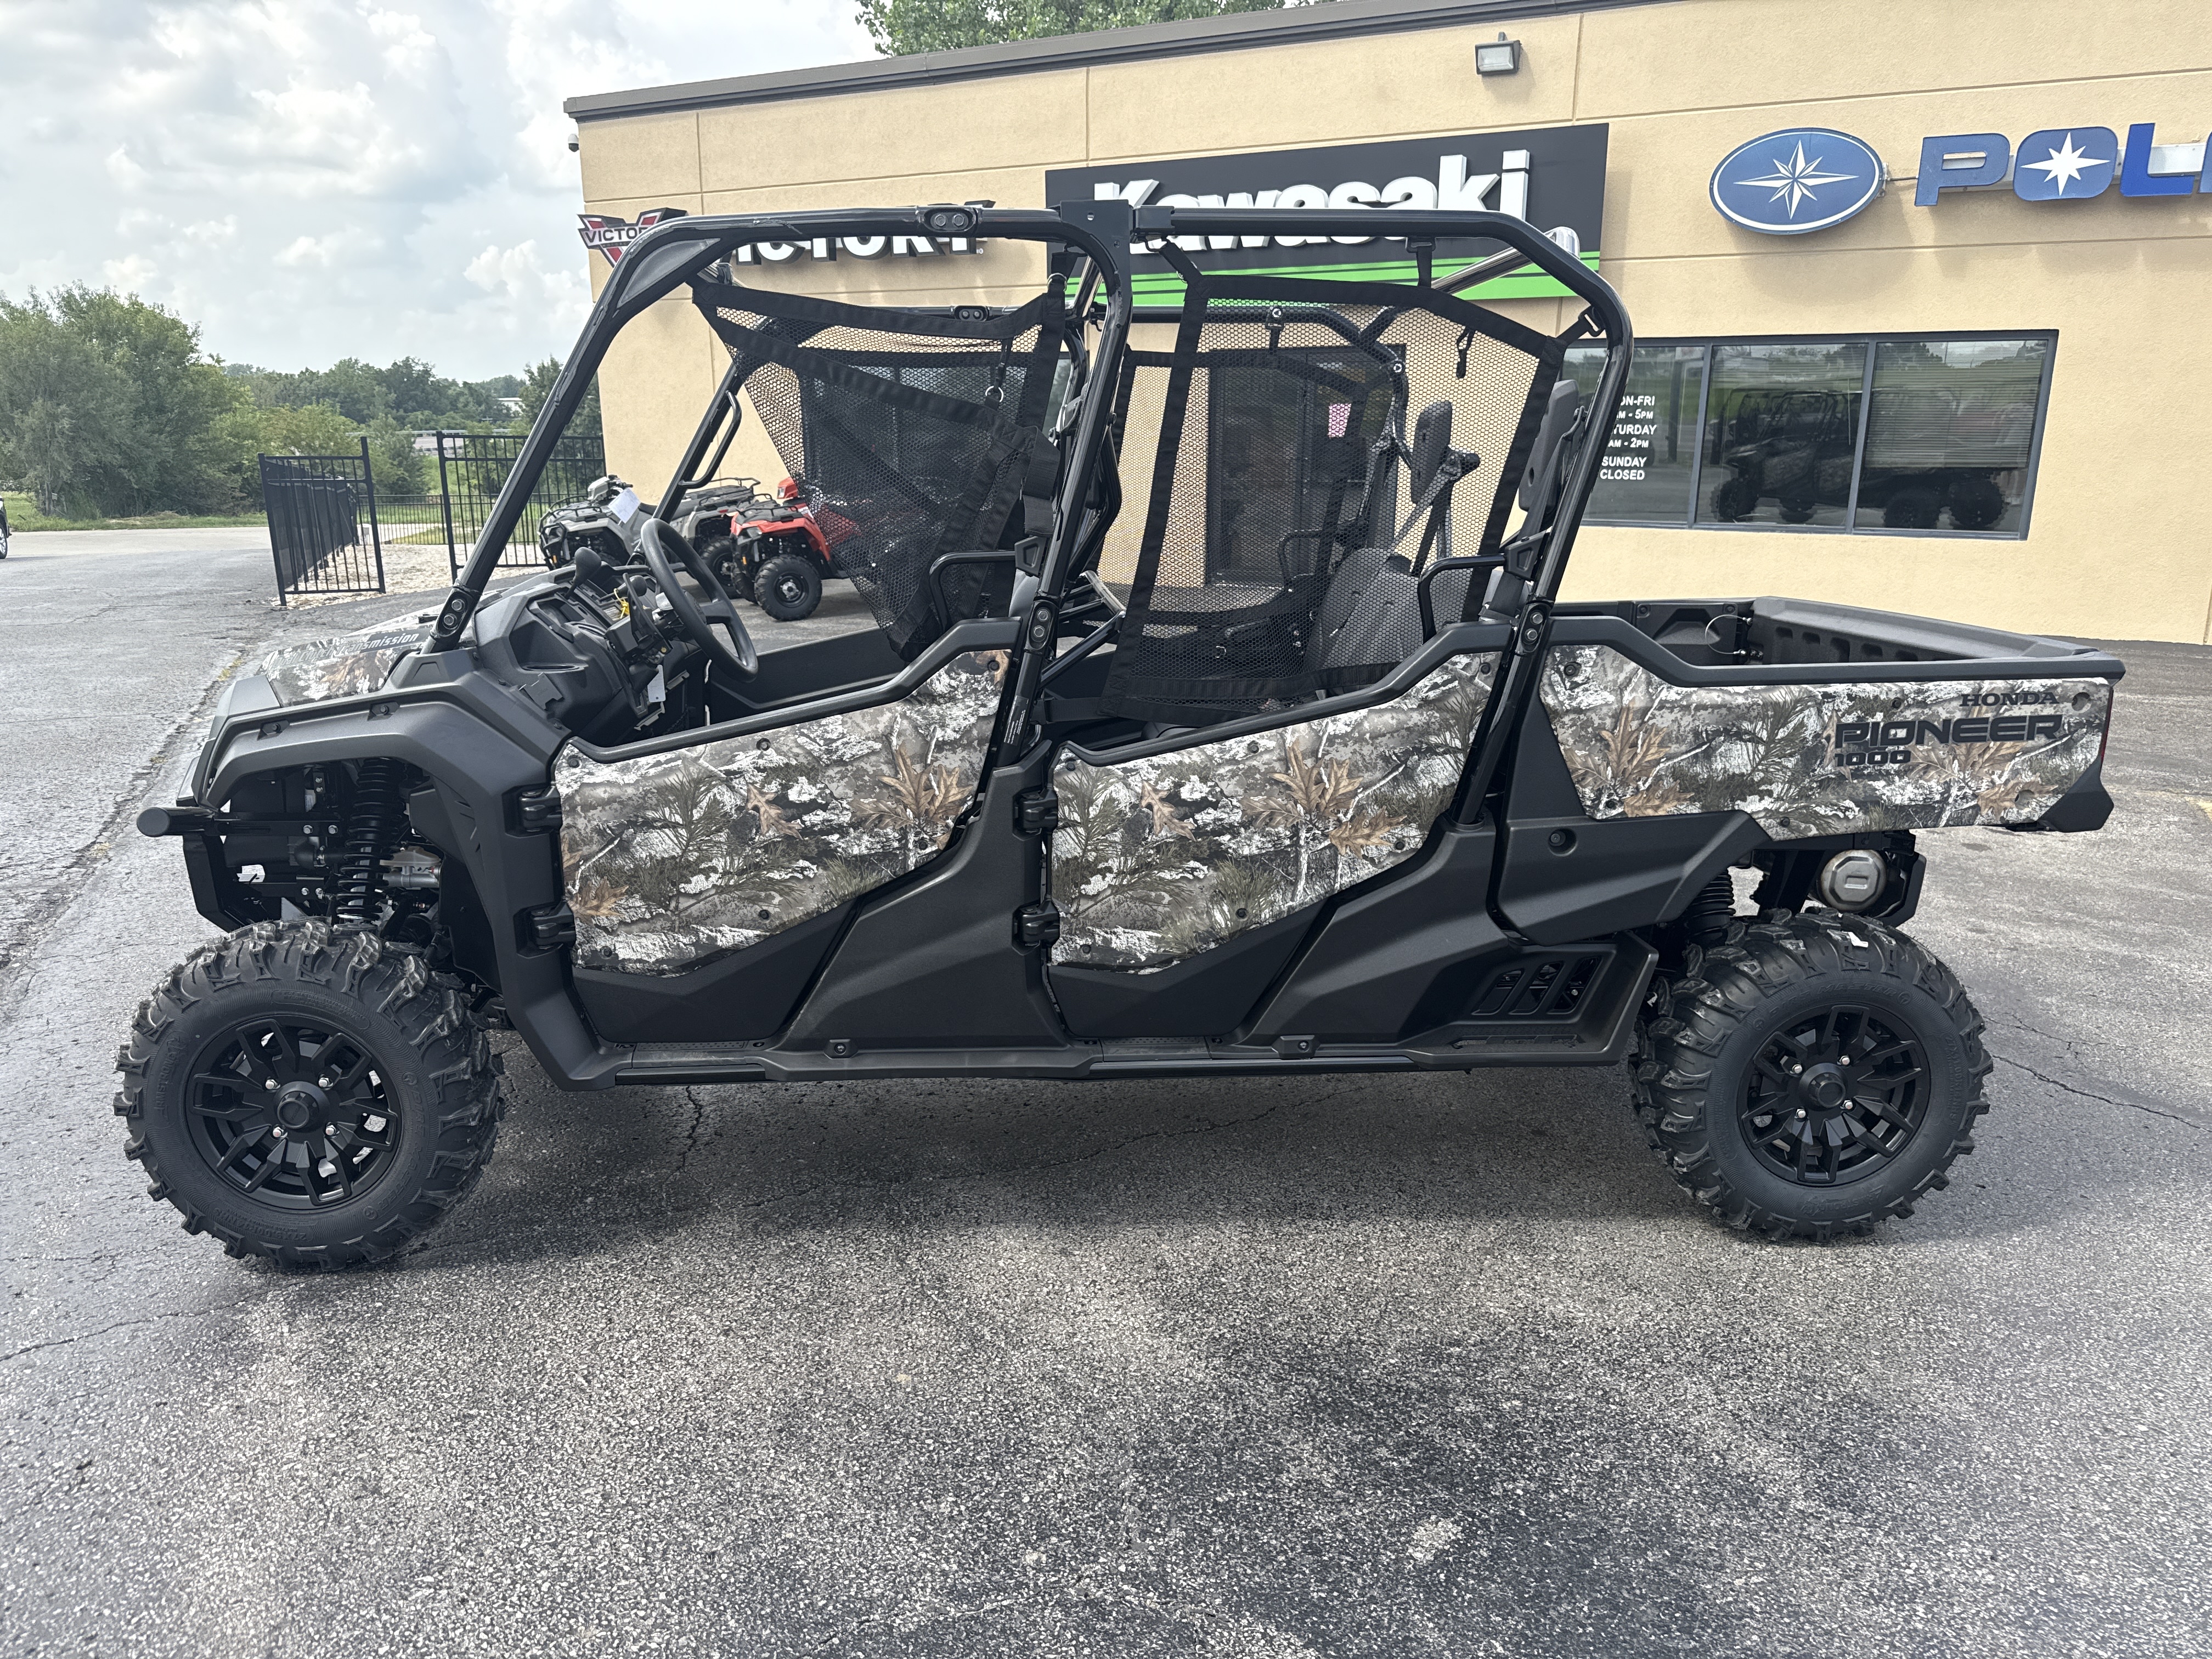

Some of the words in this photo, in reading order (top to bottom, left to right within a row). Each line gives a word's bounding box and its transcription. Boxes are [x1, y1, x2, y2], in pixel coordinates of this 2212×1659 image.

[1915, 122, 2212, 207] POL
[585, 227, 649, 242] VICTO
[1621, 396, 1655, 406] N-FRI
[1635, 409, 1654, 419] 5PM
[1613, 424, 1657, 435] TURDAY
[1608, 439, 1622, 448] AM
[1630, 437, 1649, 448] 2PM
[1601, 456, 1647, 467] SUNDAY
[1600, 469, 1645, 480] CLOSED
[336, 633, 420, 653] Transmission
[1959, 692, 2060, 707] HONDA
[1835, 715, 2063, 749] PIONEER
[1833, 750, 1911, 767] 1000
